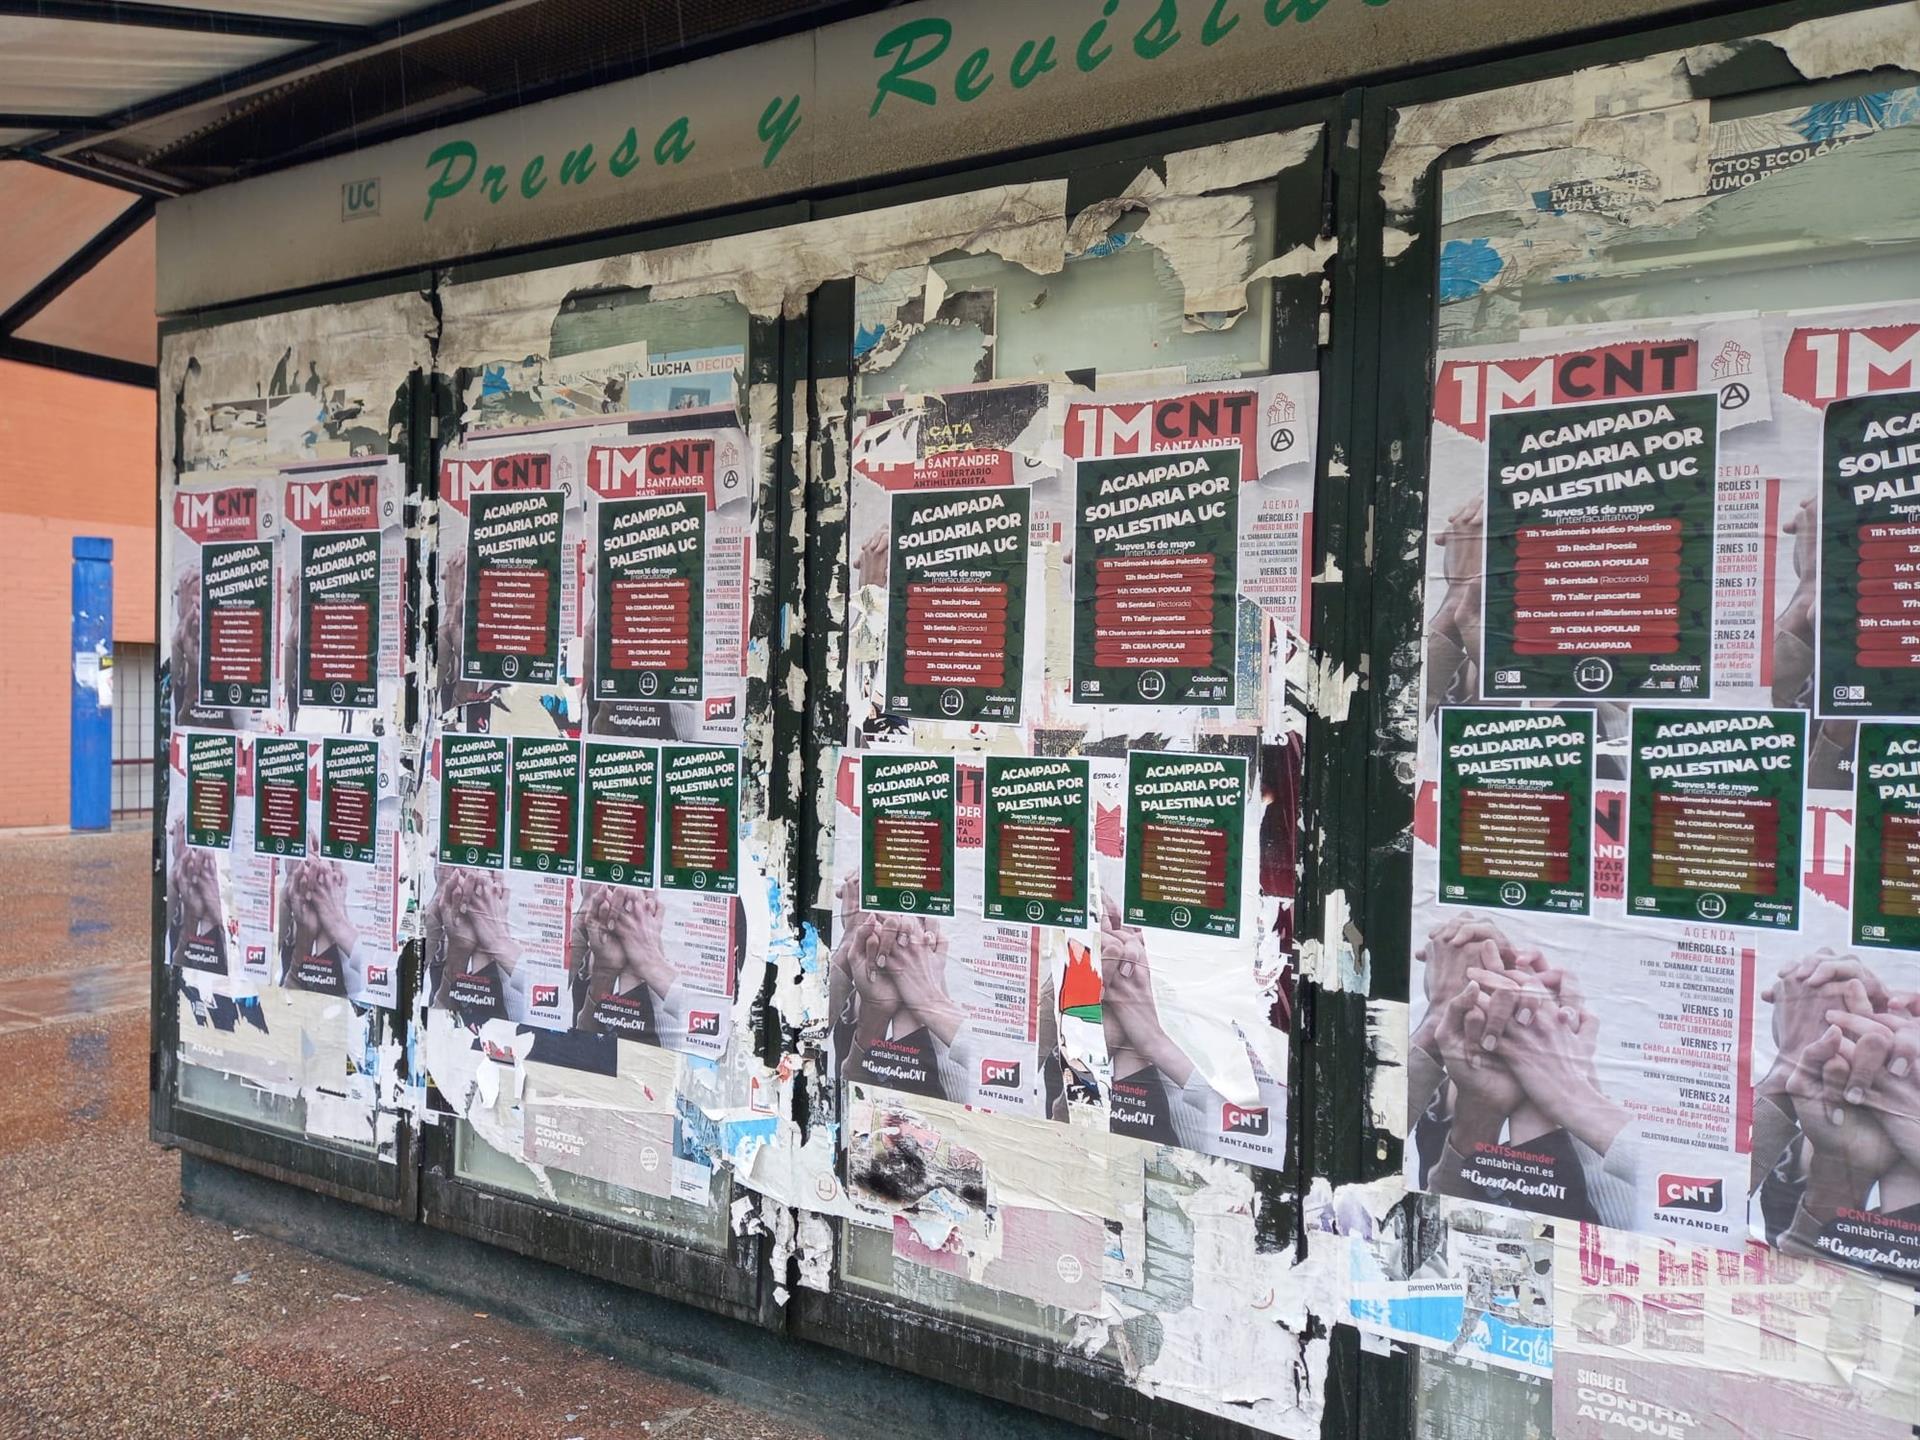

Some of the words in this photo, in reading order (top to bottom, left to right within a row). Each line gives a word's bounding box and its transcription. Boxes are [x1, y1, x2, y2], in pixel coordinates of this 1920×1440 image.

[424, 116, 695, 221] Prensa
[757, 95, 802, 169] y
[1709, 157, 1760, 175] CTOS
[349, 182, 375, 210] UC
[651, 362, 691, 376] LUCHA
[1558, 345, 1690, 397] CNT
[1156, 396, 1252, 438] CNT
[930, 423, 972, 437] CATA
[1521, 405, 1674, 453] ACAMPADA
[928, 454, 999, 469] SANTANDER
[1500, 441, 1639, 485] SOLIDARIA
[1644, 426, 1703, 454] POR
[494, 456, 547, 487] CNT
[596, 448, 646, 491] 1M
[648, 443, 711, 475] CNT
[914, 471, 938, 479] MAYO
[942, 467, 991, 478] LIBERTARIO
[1100, 457, 1209, 495] ACAMPADA
[646, 475, 704, 489] SANTANDER
[914, 477, 986, 488] ANTIMILITARISTA
[1512, 468, 1655, 509] PALESTINA
[1658, 456, 1698, 480] UC
[329, 478, 375, 506] CNT
[1085, 487, 1184, 522] SOLIDARIA
[1188, 475, 1229, 499] POR
[214, 491, 256, 516] CNT
[329, 506, 371, 518] SANTANDER
[911, 494, 1004, 525] ACAMPADA
[1541, 506, 1583, 518] Jueves
[1585, 505, 1598, 516] 16
[1600, 504, 1616, 515] de
[1618, 504, 1654, 514] mayo
[214, 517, 250, 527] SANTANDER
[613, 501, 685, 530] ACAMPADA
[1094, 511, 1196, 543] PALESTINA
[1198, 501, 1226, 521] UC
[1555, 511, 1639, 525] (Interfacultativo)
[603, 524, 669, 551] SOLIDARIA
[671, 516, 698, 534] POR
[898, 520, 983, 549] SOLIDARIA
[986, 512, 1021, 532] POR
[1541, 527, 1589, 537] Testimonio
[1591, 525, 1625, 534] Médico
[1627, 523, 1671, 532] Palestino
[212, 545, 260, 567] ACAMPADA
[313, 536, 366, 559] ACAMPADA
[609, 544, 677, 568] PALESTINA
[678, 537, 696, 552] UC
[905, 543, 992, 569] PALESTINA
[994, 535, 1017, 552] UC
[1556, 544, 1571, 552] 12h
[1573, 543, 1604, 551] Recital
[1606, 542, 1637, 550] Poesía
[205, 564, 249, 585] SOLIDARIA
[250, 558, 268, 572] POR
[305, 555, 354, 577] SOLIDARIA
[356, 549, 376, 564] POR
[1545, 561, 1560, 569] 14h
[1562, 560, 1600, 568] COMIDA
[1602, 558, 1648, 567] POPULAR
[209, 580, 254, 599] PALESTINA
[255, 575, 267, 587] UC
[309, 572, 359, 592] PALESTINA
[361, 567, 374, 580] UC
[1544, 577, 1559, 585] 16h
[1560, 576, 1597, 585] Sentada
[1600, 574, 1649, 583] (Rectorado)
[1594, 592, 1640, 600] pancartas
[1595, 608, 1641, 616] militarismo
[1649, 663, 1700, 671] Colaboran:
[709, 703, 732, 715] CNT
[1463, 714, 1566, 737] ACAMPADA
[1449, 736, 1543, 757] SOLIDARIA
[1546, 731, 1584, 747] POR
[673, 750, 725, 767] ACAMPADA
[1458, 756, 1553, 775] PALESTINA
[1555, 751, 1581, 765] UC
[665, 766, 713, 781] SOLIDARIA
[715, 762, 734, 773] POR
[1146, 761, 1225, 777] ACAMPADA
[670, 780, 719, 794] PALESTINA
[720, 777, 733, 787] UC
[1134, 779, 1207, 795] SOLIDARIA
[1209, 776, 1239, 789] POR
[1141, 797, 1214, 811] PALESTINA
[1216, 794, 1236, 806] UC
[1684, 927, 1736, 941] AGENDA
[1677, 941, 1727, 955] MIÉRCOLES
[1671, 951, 1701, 963] PRIMERO
[1703, 955, 1714, 964] DE
[1715, 956, 1736, 966] MAYO
[1682, 1003, 1719, 1017] VIERNES
[1723, 1008, 1733, 1019] 10
[1680, 1037, 1718, 1051] VIERNES
[1721, 1043, 1732, 1053] 17
[871, 1050, 919, 1065] cantabria.cnt.es
[986, 1067, 1015, 1082] CNT
[979, 1089, 1024, 1104] SANTANDER
[1679, 1088, 1716, 1103] VIERNES
[1718, 1094, 1730, 1104] 24
[1228, 1111, 1262, 1128] CNT
[535, 1138, 581, 1156] ATAQUE
[1219, 1136, 1273, 1154] SANTANDER
[1473, 1141, 1556, 1165] @CNTSantander
[1475, 1156, 1554, 1178] cantabria.cnt.es
[1460, 1168, 1567, 1200] #CuentaConCNT
[1666, 1183, 1714, 1204] CNT
[1653, 1212, 1729, 1234] SANTANDER
[1577, 1369, 1610, 1392] SIGUE
[1577, 1404, 1685, 1440] ATAQUE
